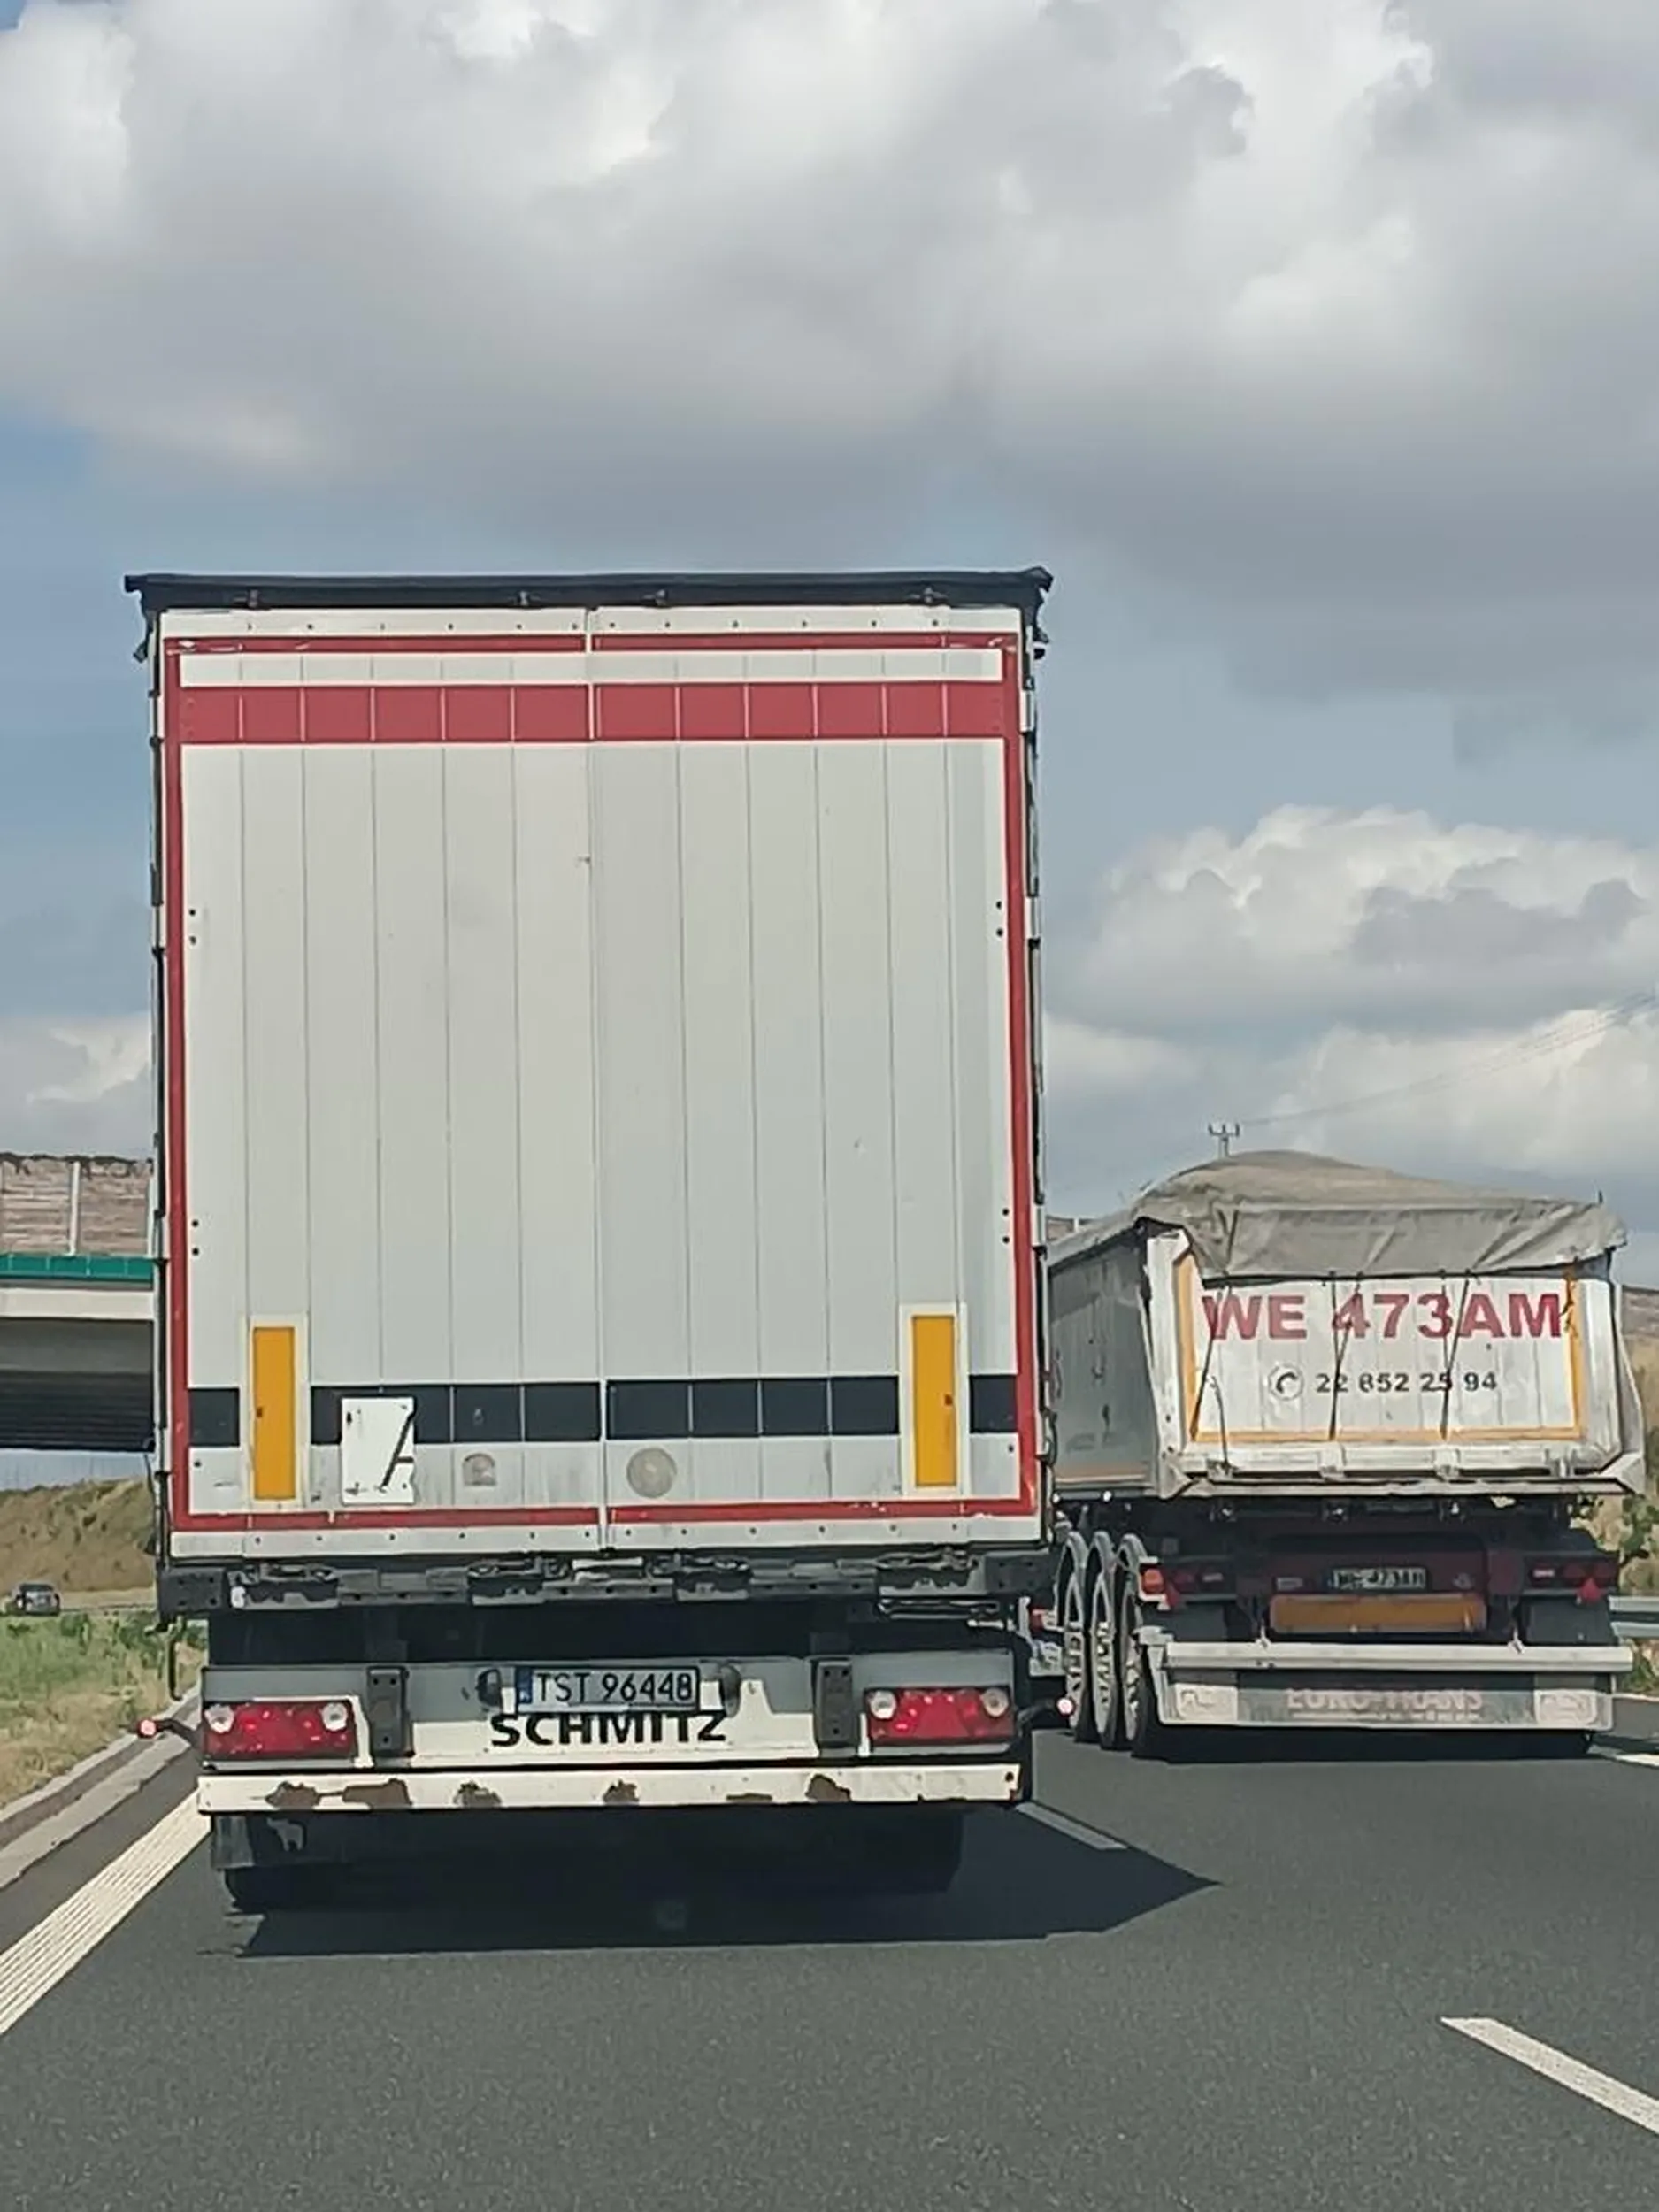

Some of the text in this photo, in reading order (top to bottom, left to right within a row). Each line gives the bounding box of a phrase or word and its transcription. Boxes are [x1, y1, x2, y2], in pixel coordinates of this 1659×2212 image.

[1202, 1293, 1562, 1340] WE 473AM
[1316, 1372, 1349, 1394] 22
[1463, 1371, 1497, 1392] 94
[536, 1671, 693, 1702] TST 96448
[490, 1711, 727, 1747] SCHMITZ
